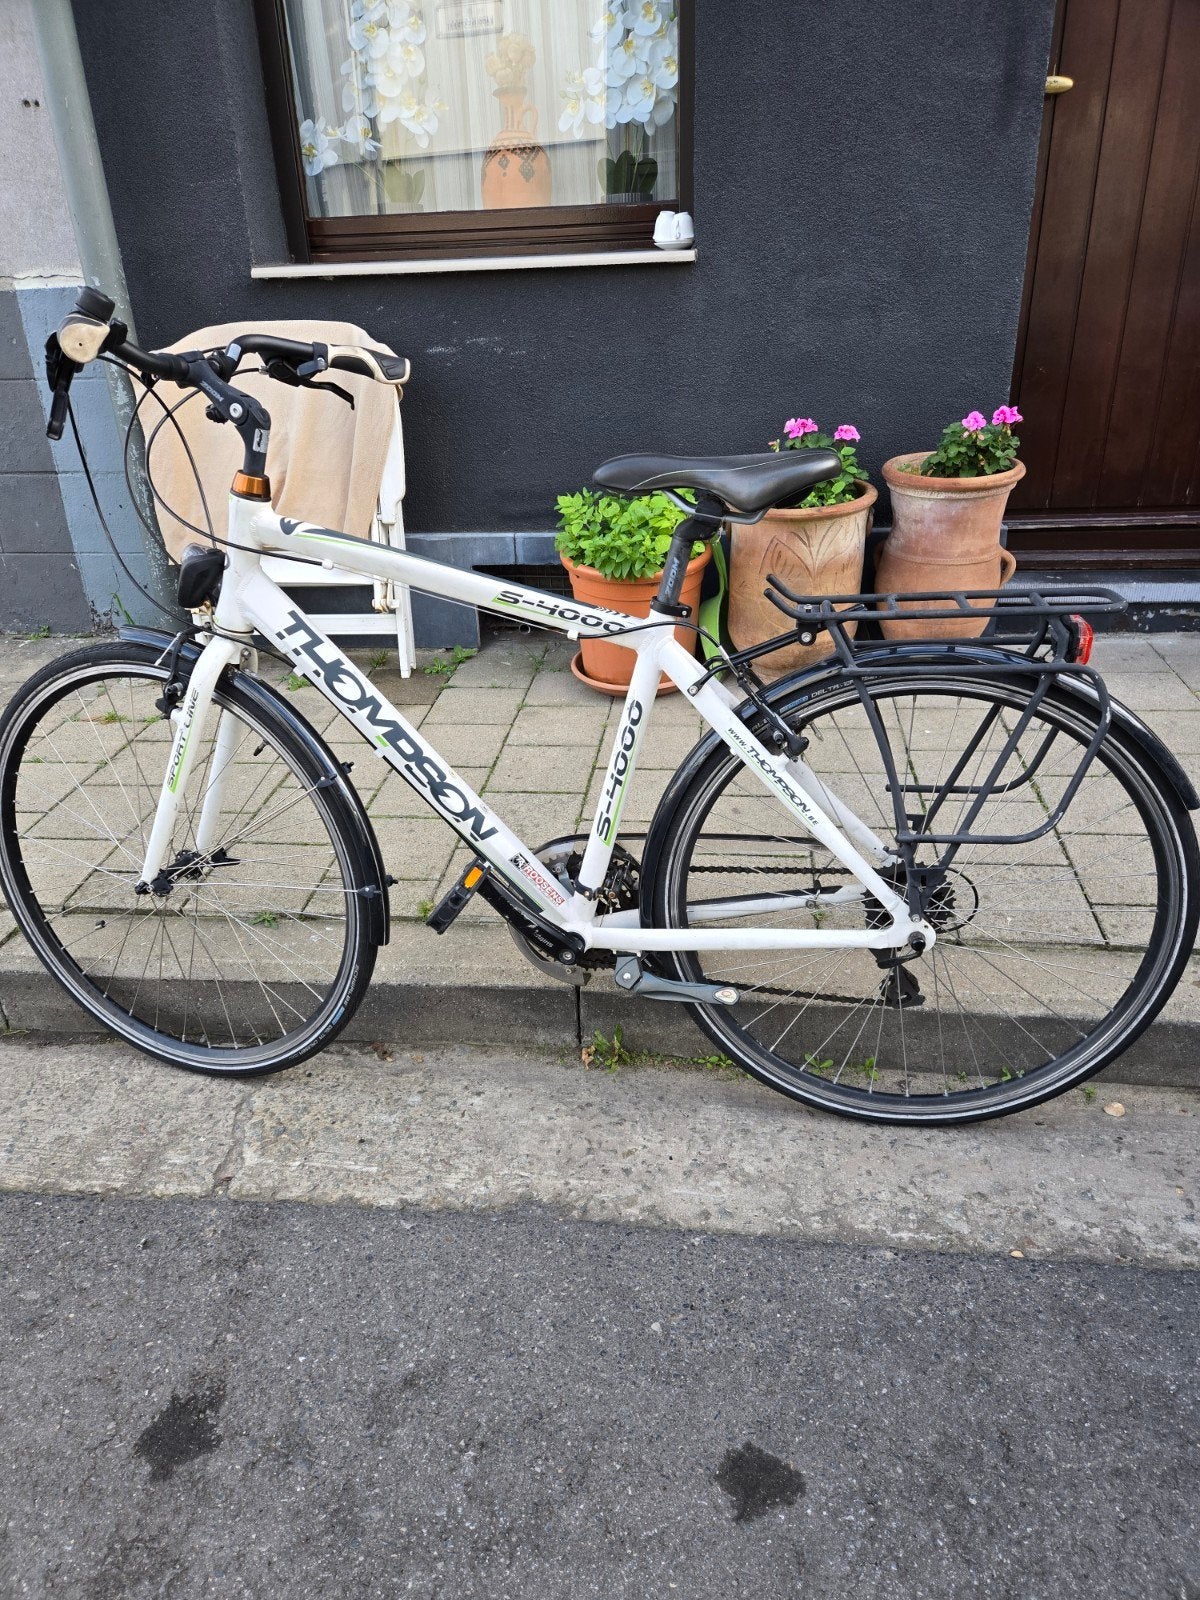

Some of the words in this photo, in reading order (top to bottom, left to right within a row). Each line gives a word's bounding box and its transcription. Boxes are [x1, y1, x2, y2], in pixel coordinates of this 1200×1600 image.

[200, 380, 224, 401] ZOOM
[664, 556, 680, 596] ZOOM
[496, 590, 627, 632] S-4000
[167, 731, 186, 787] SPORT
[184, 687, 199, 728] LINE
[276, 609, 499, 842] THOMPSON
[597, 699, 643, 841] S-4000
[523, 864, 564, 905] ROOSENS
